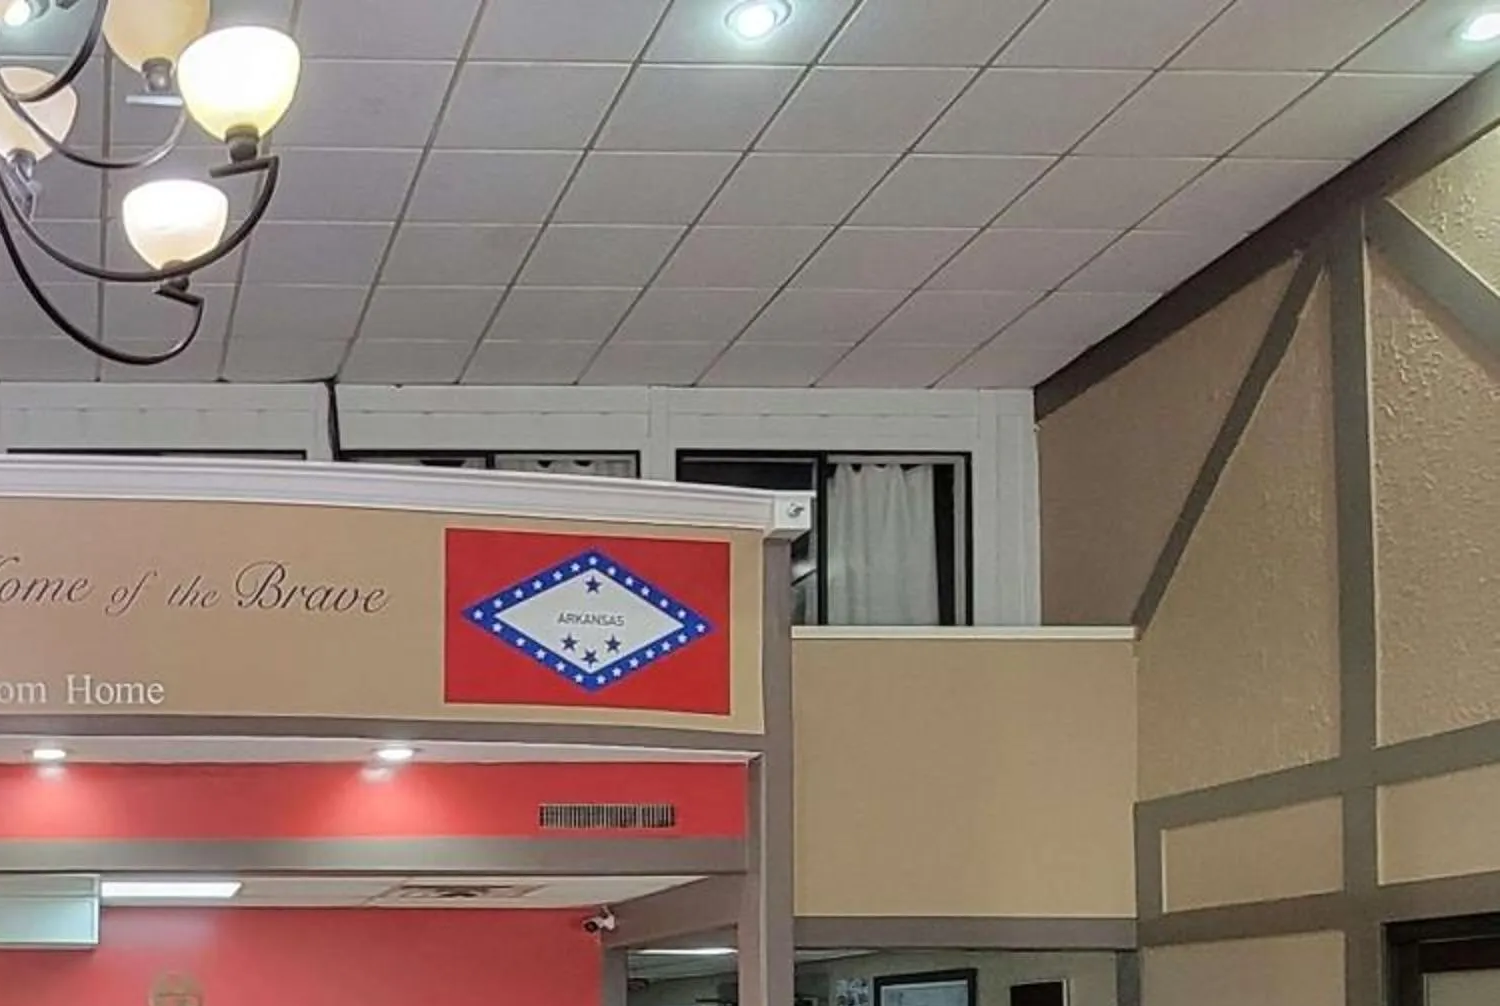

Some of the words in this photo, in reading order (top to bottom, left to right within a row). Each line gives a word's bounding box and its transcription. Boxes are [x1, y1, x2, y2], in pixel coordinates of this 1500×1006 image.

[104, 569, 157, 617] of
[167, 575, 222, 609] the
[234, 560, 388, 614] Brave
[556, 611, 626, 627] ARKANSAS
[66, 674, 166, 705] Home
